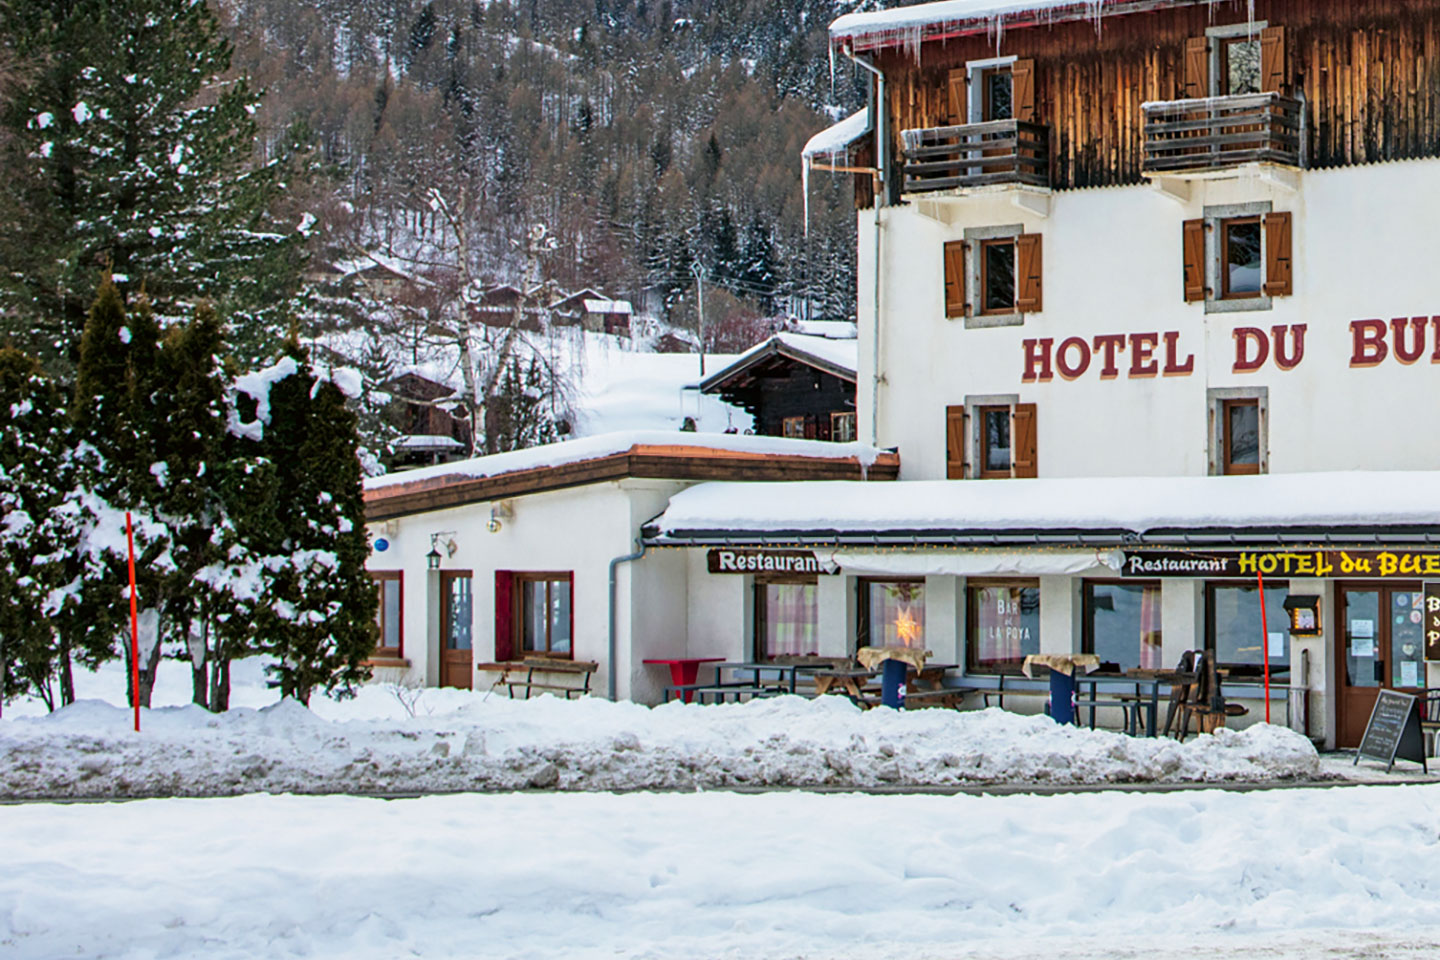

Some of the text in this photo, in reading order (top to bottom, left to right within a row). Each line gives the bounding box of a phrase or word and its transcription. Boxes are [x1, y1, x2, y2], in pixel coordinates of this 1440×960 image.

[1021, 331, 1195, 383] HOTEL
[1232, 324, 1308, 374] DU
[1128, 556, 1229, 573] Restaurant
[1238, 551, 1333, 577] HOTEL
[1340, 551, 1371, 573] du
